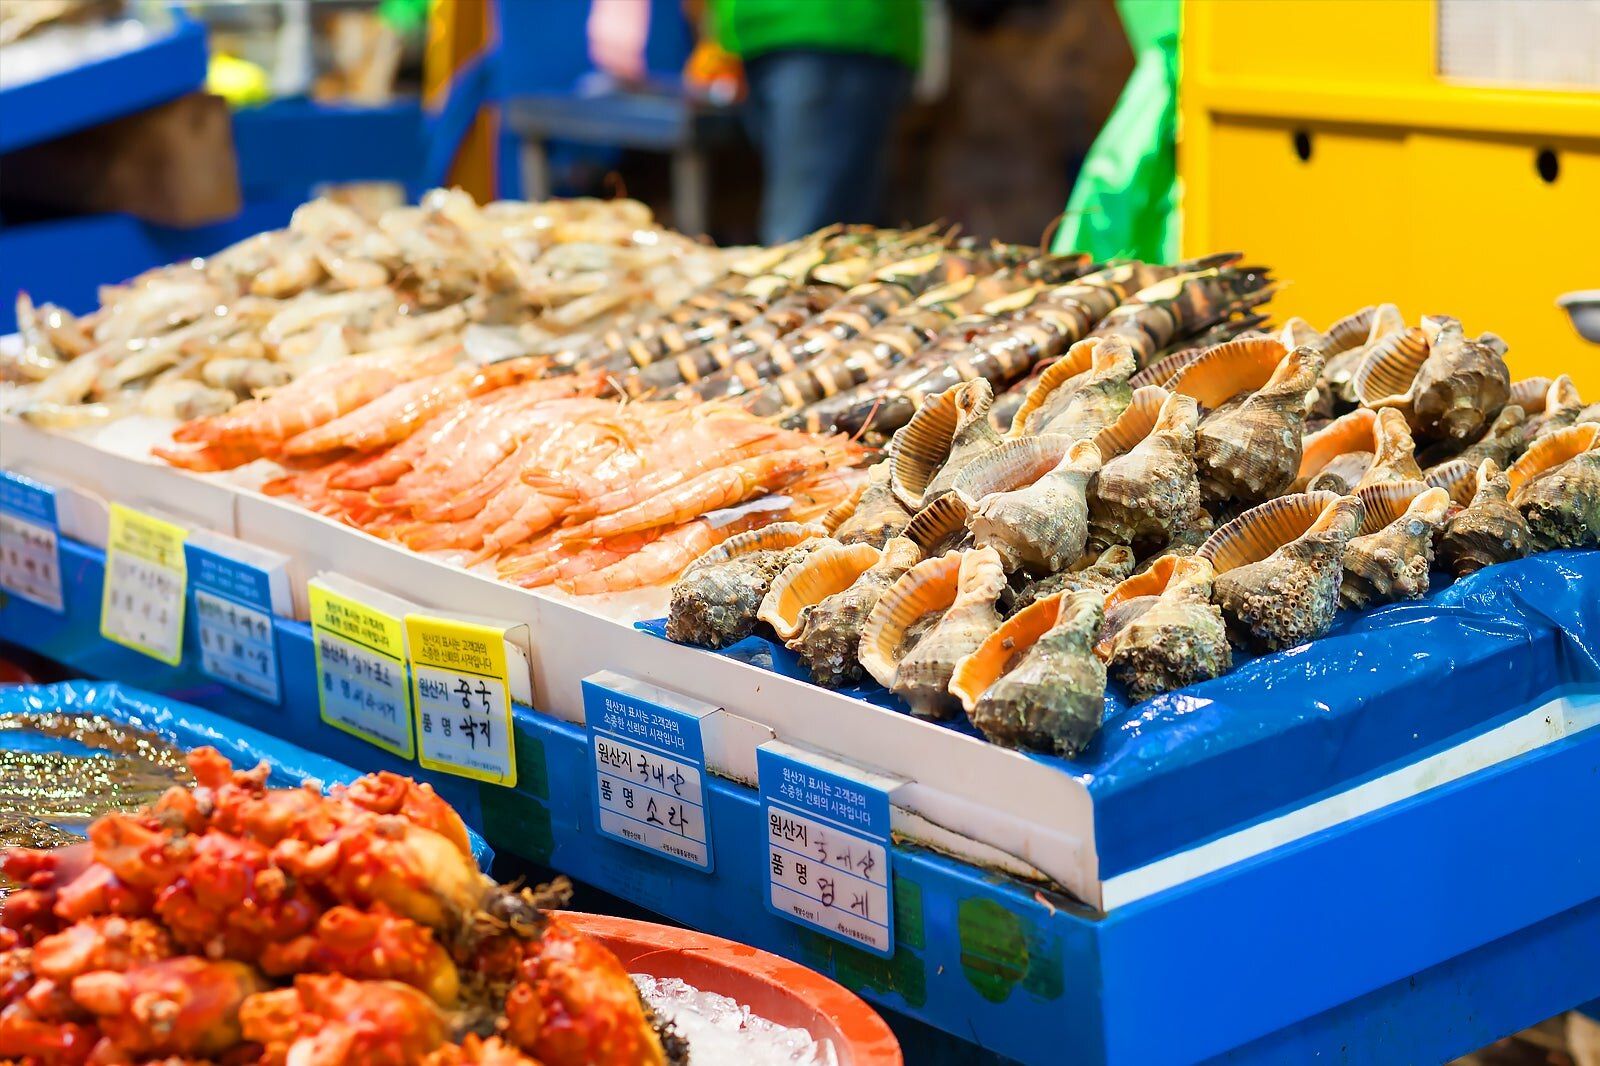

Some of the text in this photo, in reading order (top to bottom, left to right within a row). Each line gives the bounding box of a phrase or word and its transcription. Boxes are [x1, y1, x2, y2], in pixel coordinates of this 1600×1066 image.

[421, 631, 441, 647] 원산지
[418, 678, 492, 715] 원산지 중국
[604, 712, 685, 751] 소중한 신뢰의 시작입니다
[605, 698, 680, 735] 원산지 표시는 고객과의
[598, 742, 685, 796] 원산지 국내산
[782, 767, 866, 809] 원산지 표시는 고객과의
[646, 796, 689, 836] 소라
[779, 783, 871, 826] 소중한 신뢰의 시작입니다
[769, 814, 808, 848] 원산지
